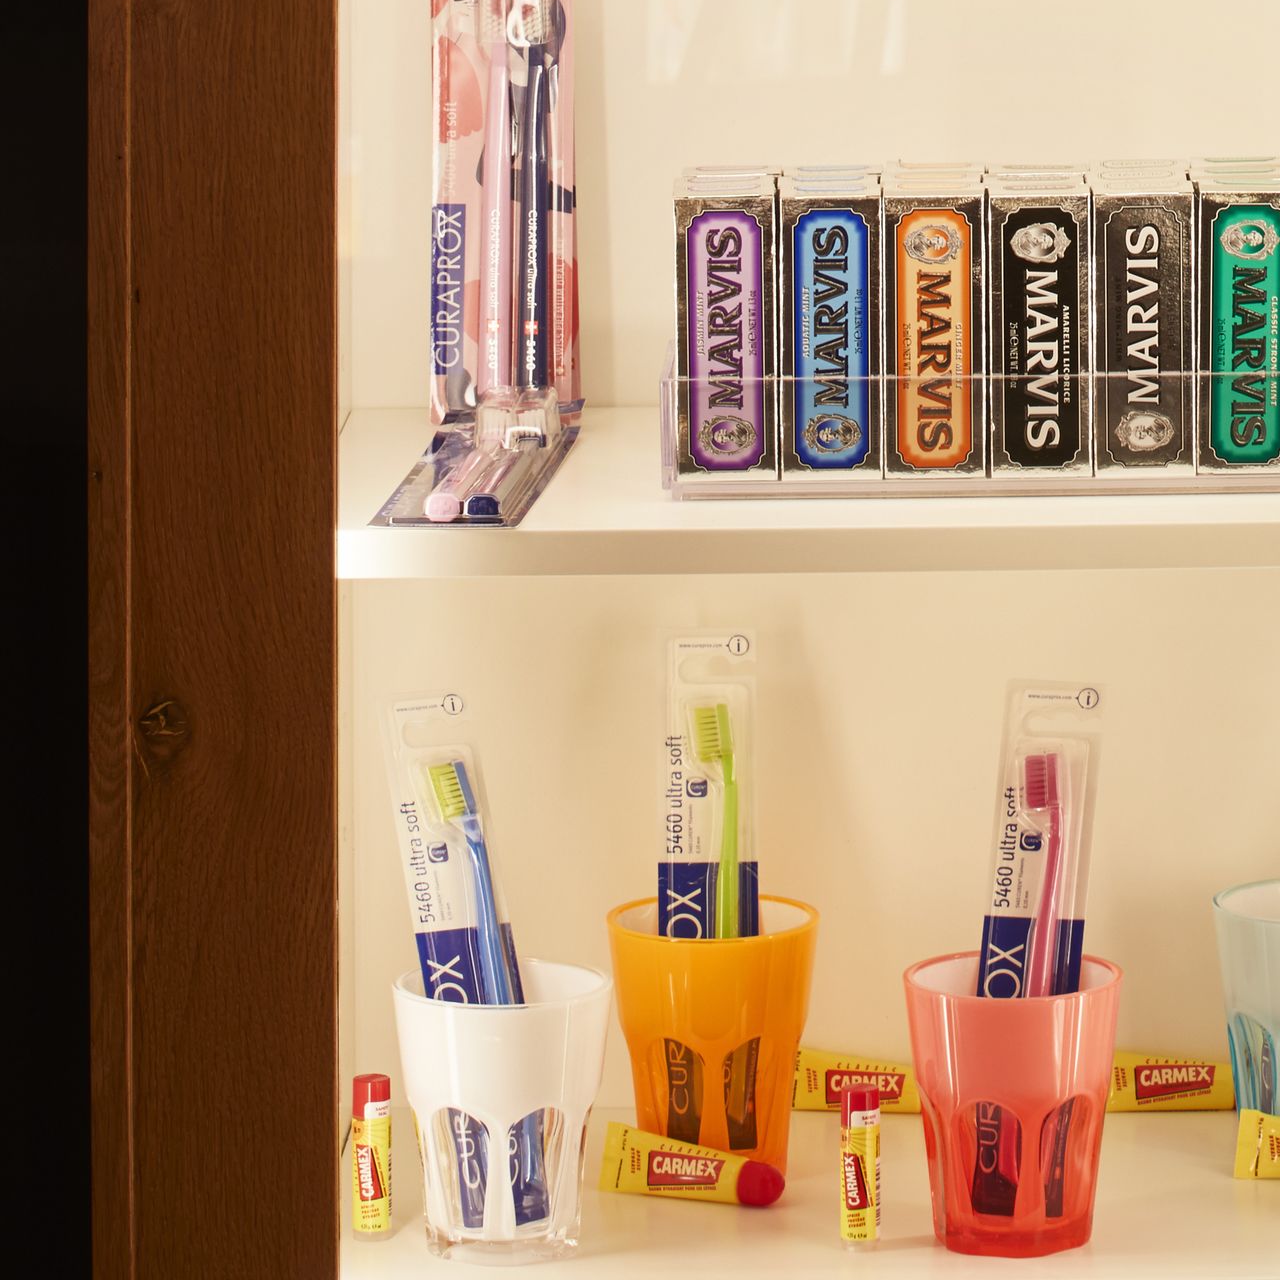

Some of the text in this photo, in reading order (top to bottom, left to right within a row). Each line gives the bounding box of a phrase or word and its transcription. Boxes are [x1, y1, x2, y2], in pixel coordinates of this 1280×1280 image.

[435, 211, 462, 368] CURAPROX
[705, 226, 744, 410] MARVIS
[802, 286, 810, 358] AQUATIC MINT
[812, 225, 849, 409] MARVIS
[1125, 225, 1160, 405] MARVIS
[916, 269, 954, 452] MARVIS
[1025, 269, 1060, 449] MARVIS
[1062, 305, 1070, 403] AMARELLI LICORICE
[1231, 264, 1268, 449] MARVIS
[1270, 338, 1278, 377] STRONG
[665, 735, 683, 854] 5460 ultra soft
[1000, 823, 1018, 861] ultra
[400, 801, 436, 924] 5460 ultra soft
[994, 866, 1013, 908] 5460
[1140, 1066, 1211, 1087] CARMEX
[357, 1147, 375, 1199] CARMEX
[652, 1156, 719, 1179] CARMEX
[844, 1155, 860, 1206] CARMEX
